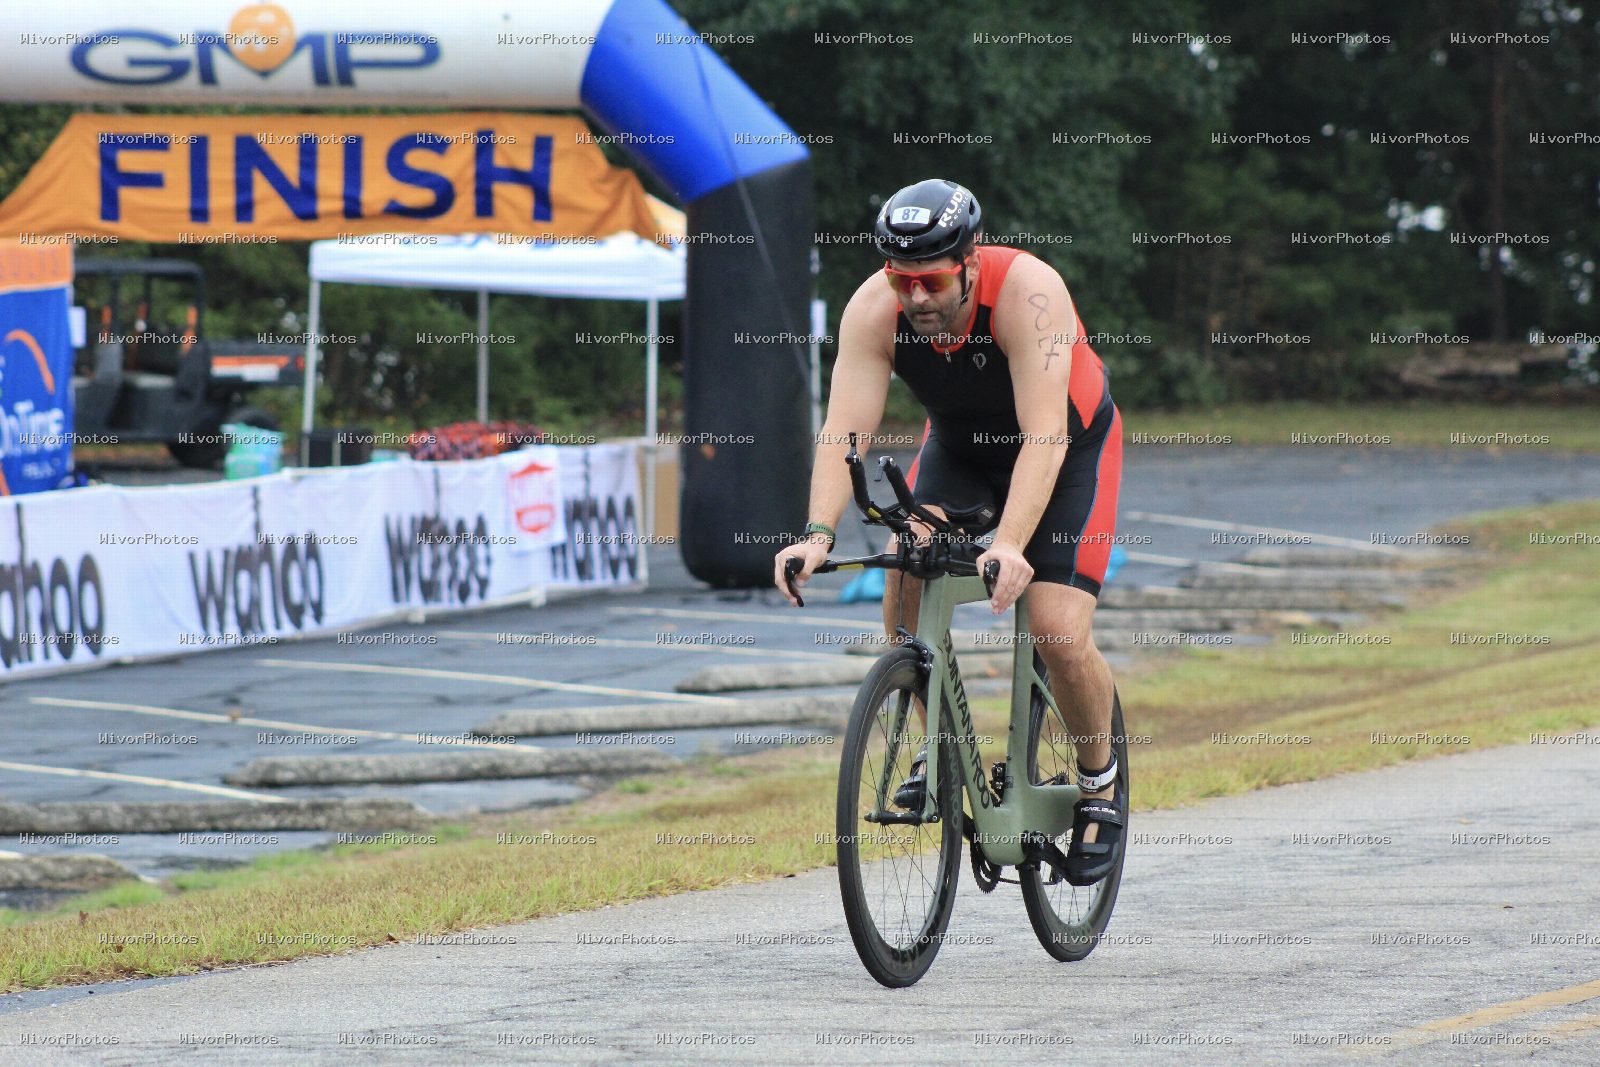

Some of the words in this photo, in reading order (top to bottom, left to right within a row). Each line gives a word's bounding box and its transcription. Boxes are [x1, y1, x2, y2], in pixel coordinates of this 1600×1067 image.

[71, 28, 441, 88] GMP
[98, 130, 553, 223] FINISH
[902, 208, 920, 221] 87
[1028, 293, 1059, 371] 87
[188, 486, 325, 635] wahoo
